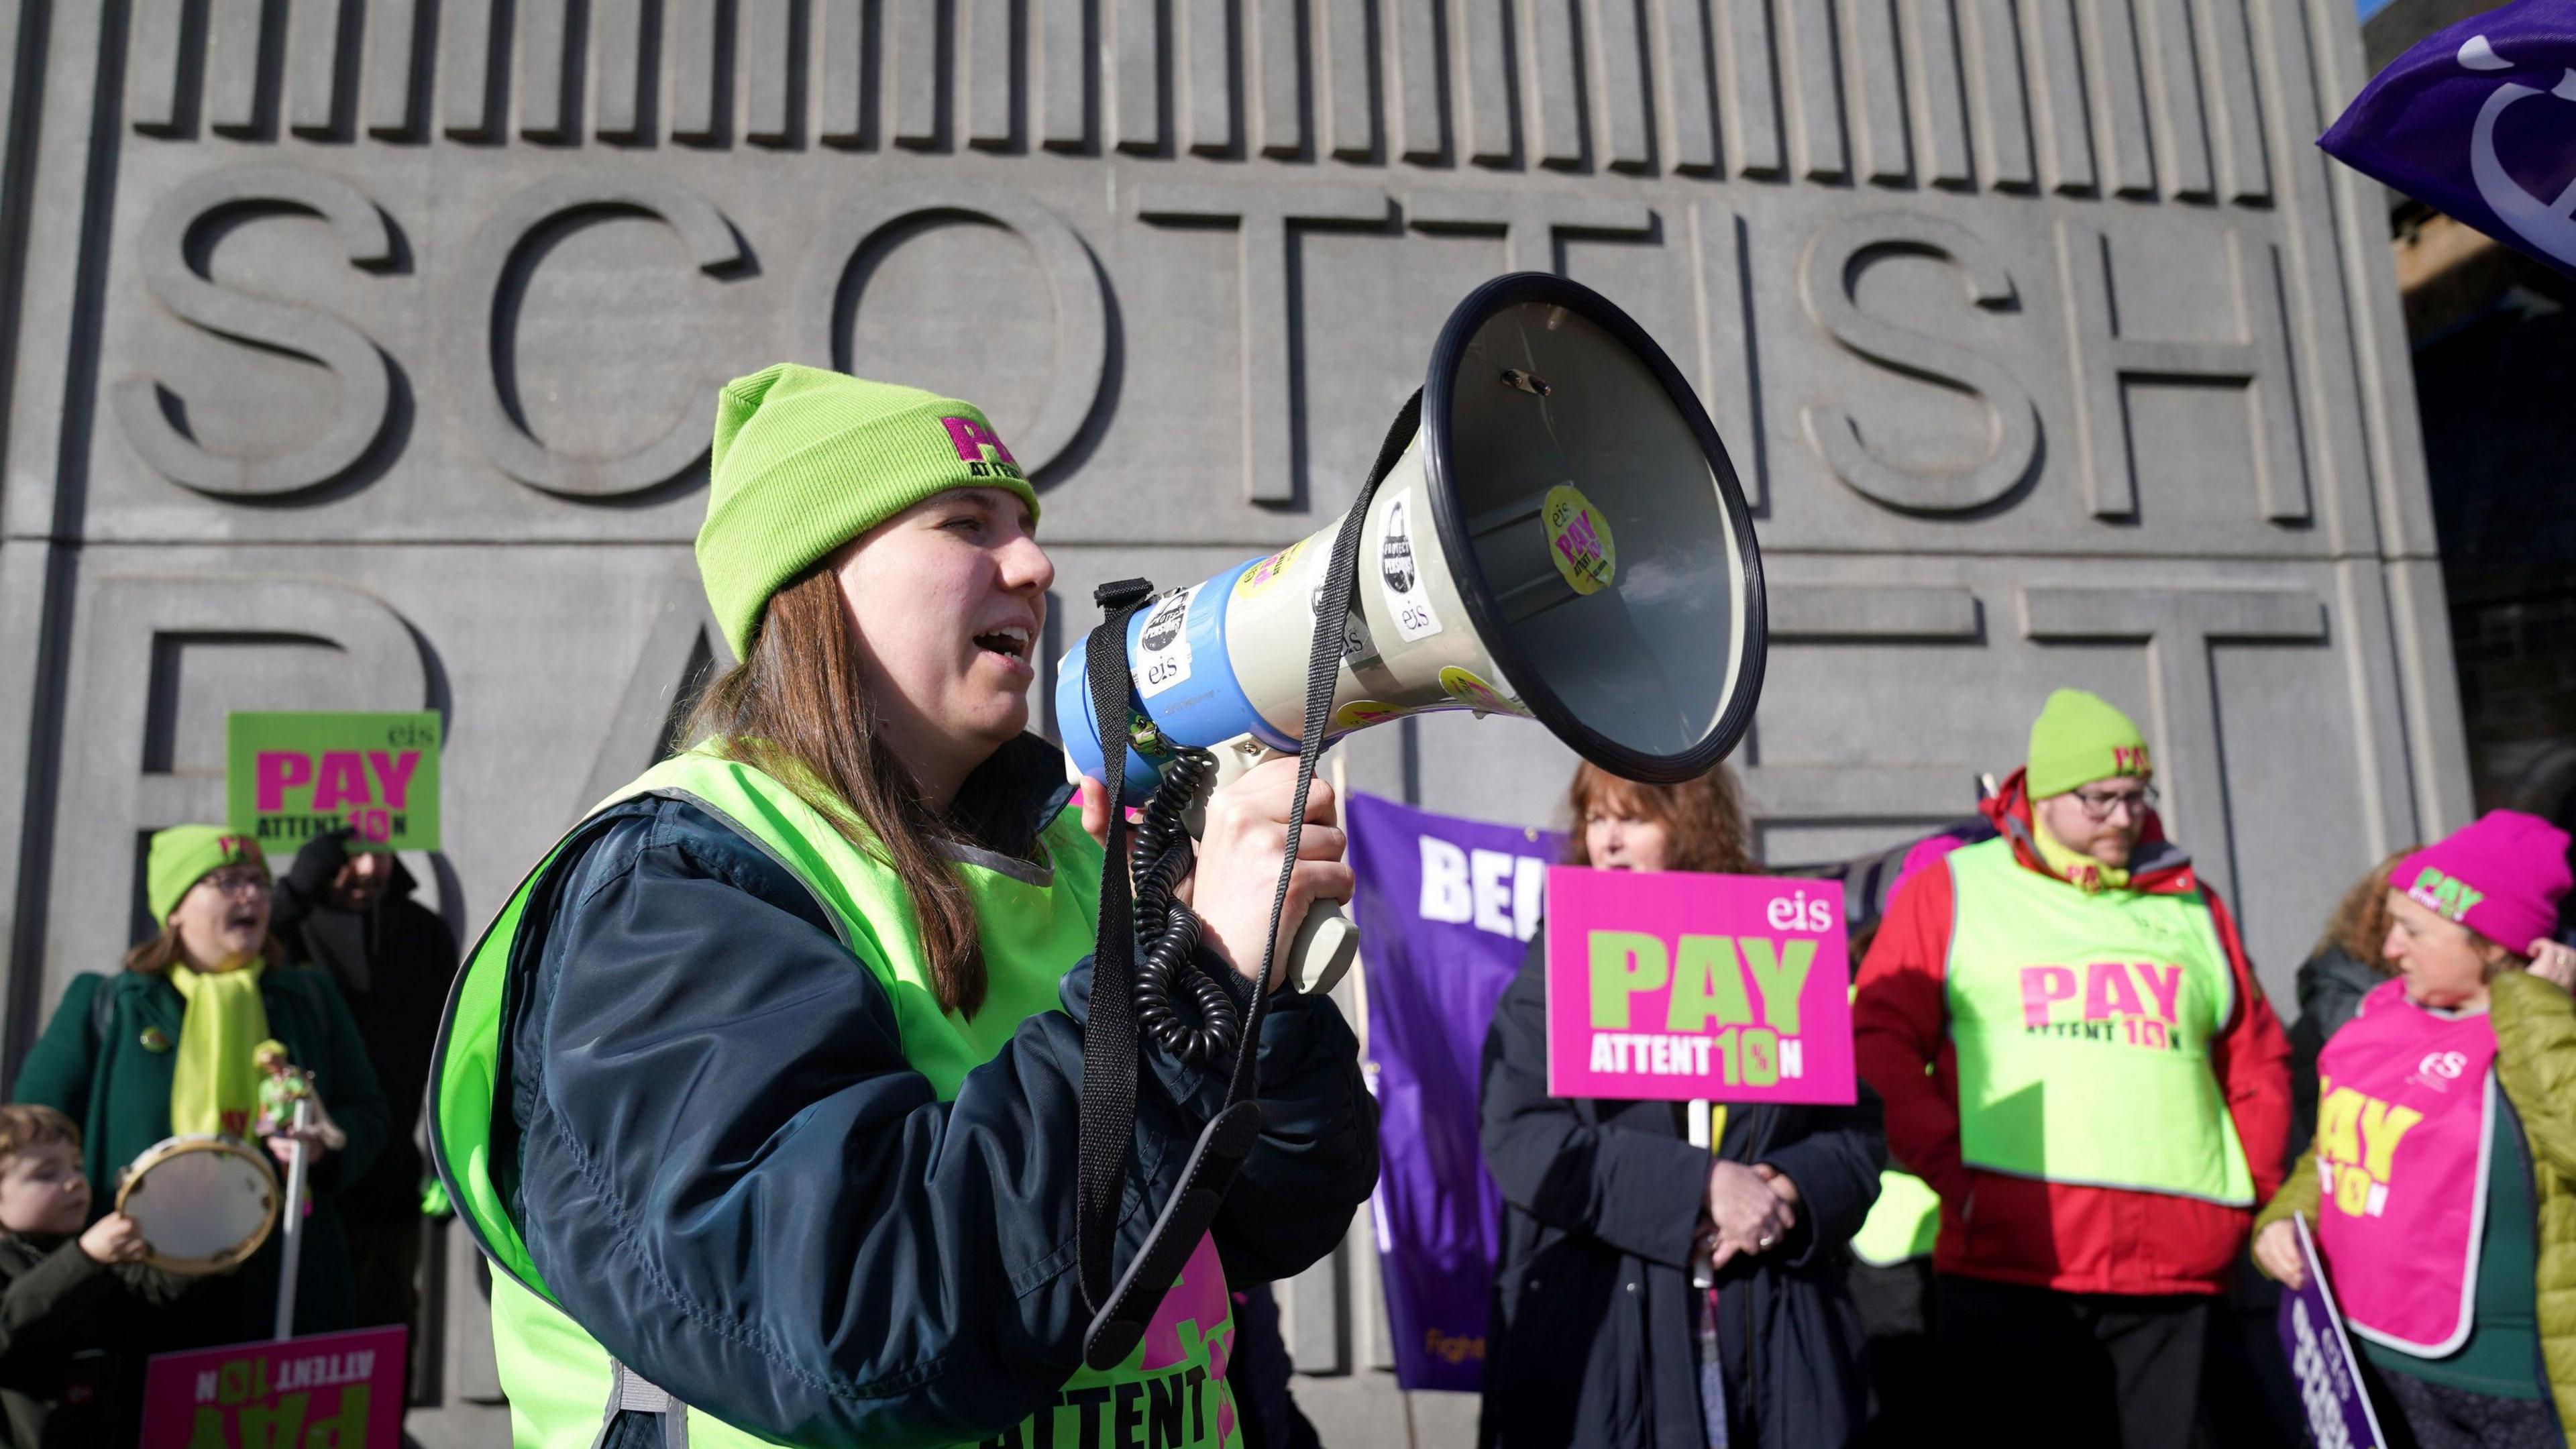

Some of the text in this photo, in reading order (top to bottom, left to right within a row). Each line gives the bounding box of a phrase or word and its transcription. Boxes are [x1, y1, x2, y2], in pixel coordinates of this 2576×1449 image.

[114, 164, 2311, 527] SCOTTISH
[1556, 509, 1595, 565] PAY
[1402, 600, 1429, 629] eis
[1148, 655, 1177, 684] eis
[387, 721, 434, 747] eis
[256, 750, 423, 812] PAY
[1766, 890, 1833, 932] eis
[2415, 866, 2484, 911] PAY
[1588, 929, 1819, 1036] PAY
[2019, 962, 2184, 1025] PAY
[2317, 1075, 2426, 1183] AY
[185, 1385, 372, 1449] PAY
